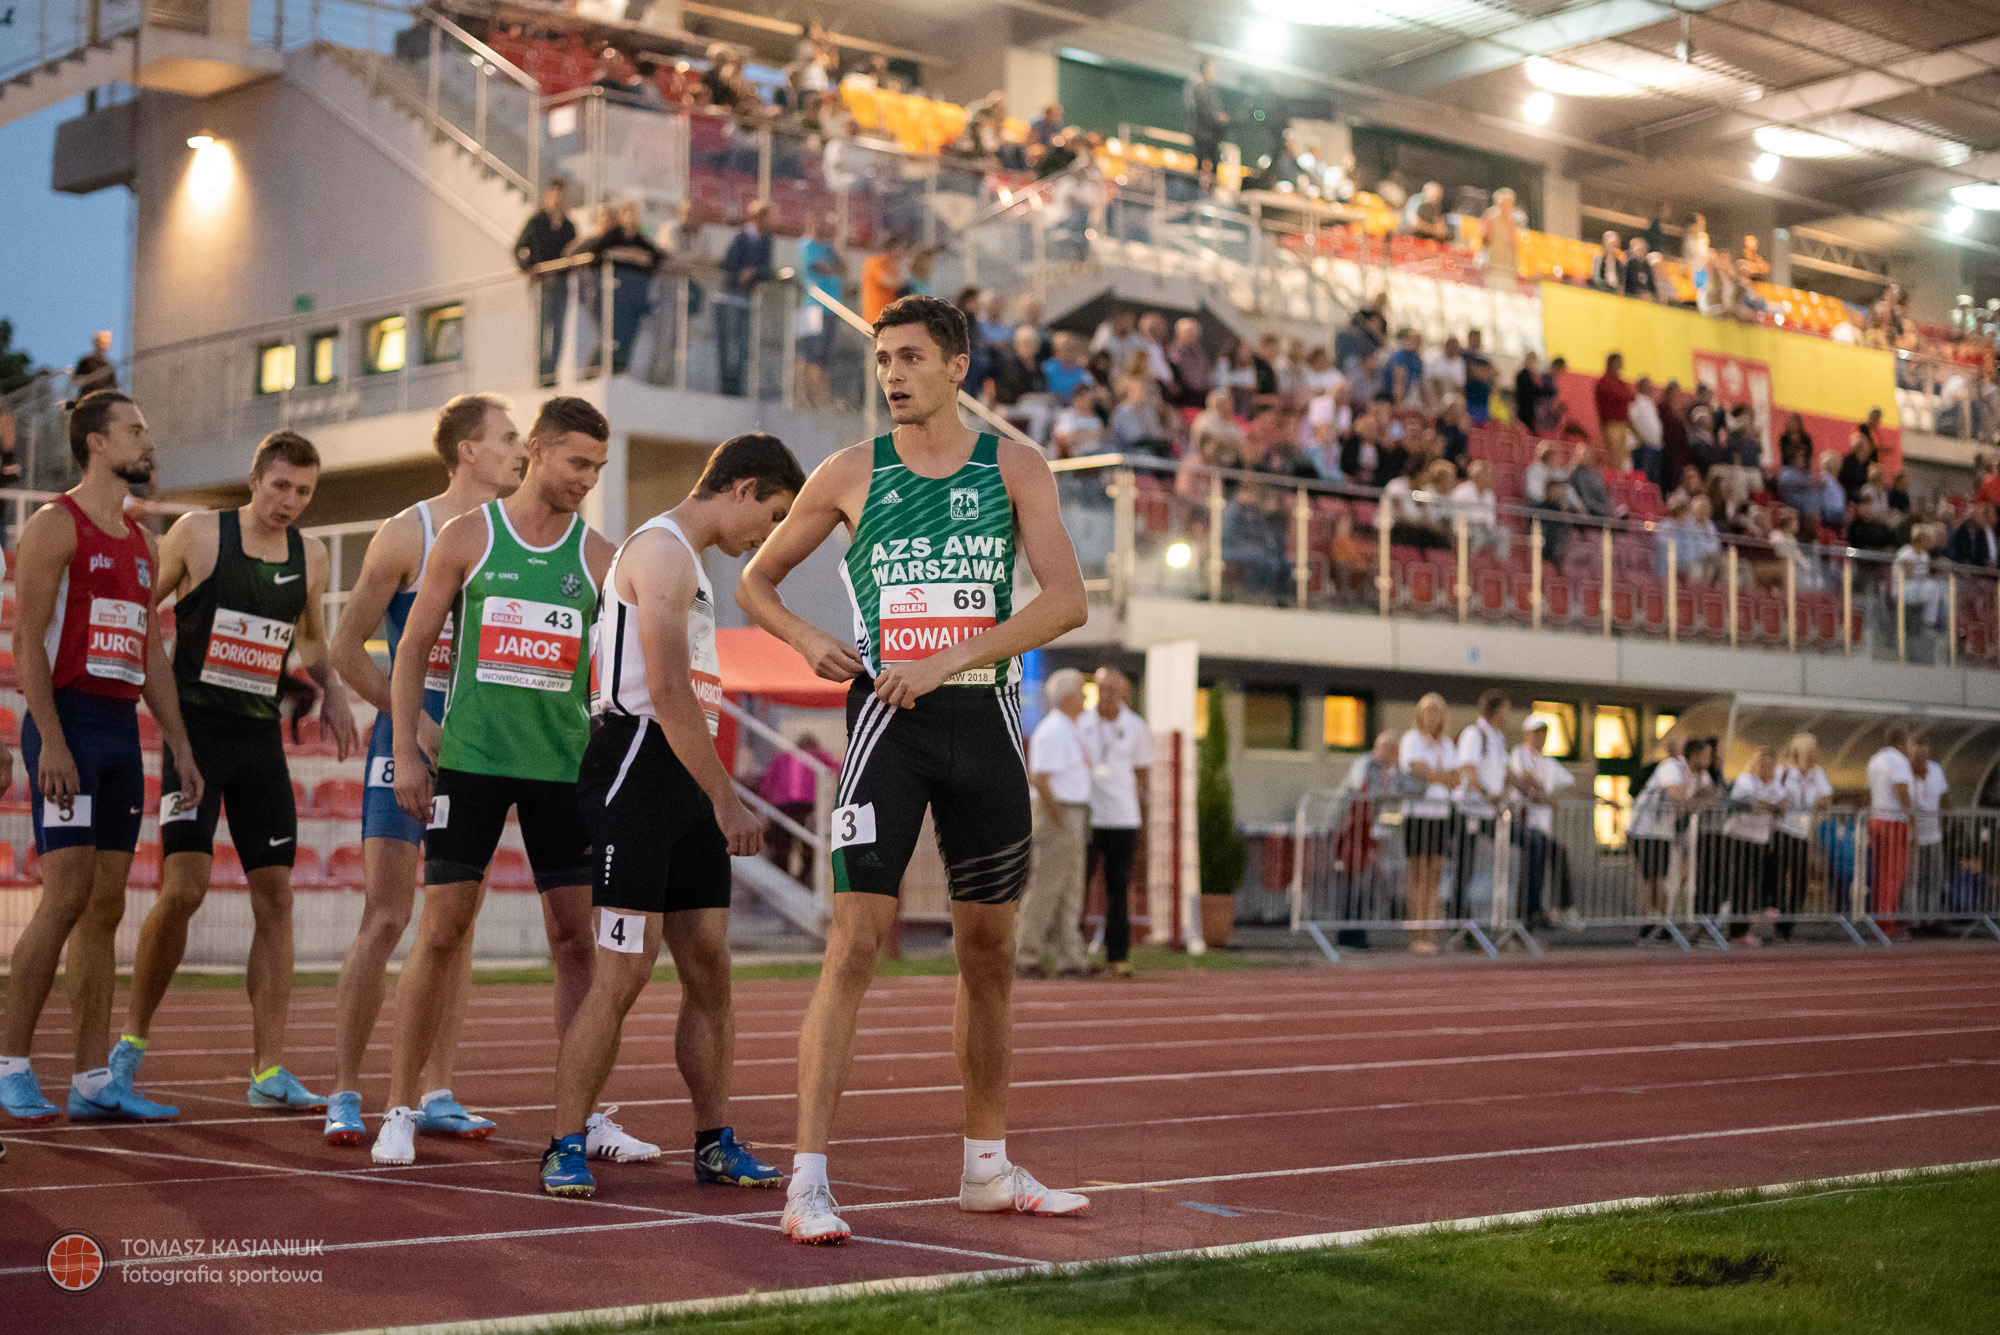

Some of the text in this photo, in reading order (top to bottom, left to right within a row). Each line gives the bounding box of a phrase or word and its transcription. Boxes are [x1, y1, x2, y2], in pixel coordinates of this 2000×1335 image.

[871, 537, 932, 566] AZS
[872, 559, 1006, 587] WARSZAWA
[892, 604, 925, 612] ORLEN
[953, 589, 986, 609] 69
[544, 610, 573, 629] 43
[262, 624, 291, 642] 114
[208, 640, 282, 671] BORKOWSKI
[428, 645, 451, 664] BR
[494, 635, 561, 662] JAROS
[967, 674, 989, 682] 2018
[381, 760, 394, 784] 8
[841, 810, 857, 842] 3
[610, 917, 626, 946] 4
